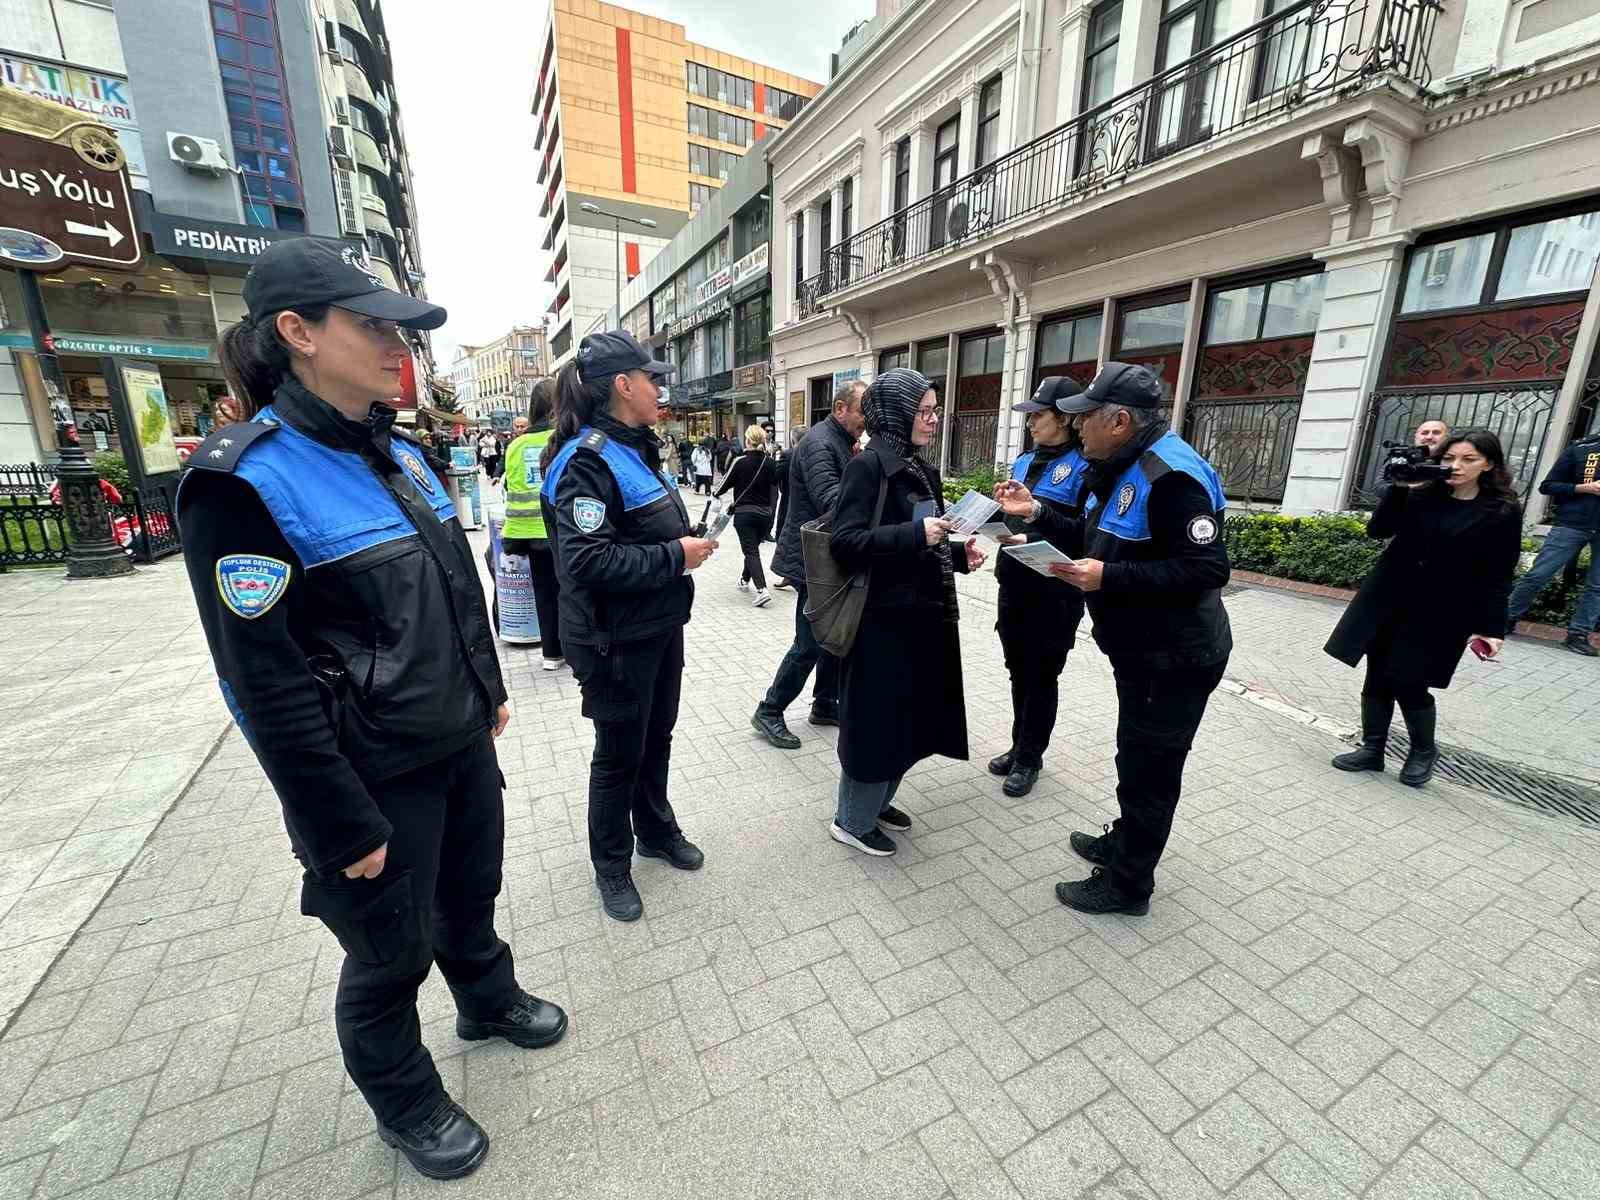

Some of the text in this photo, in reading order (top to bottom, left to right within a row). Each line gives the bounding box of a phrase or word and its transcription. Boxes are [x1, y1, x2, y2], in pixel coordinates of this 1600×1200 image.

[0, 57, 128, 105] İATRİK
[40, 168, 115, 209] Yolu
[173, 228, 271, 256] PEDİATRİ
